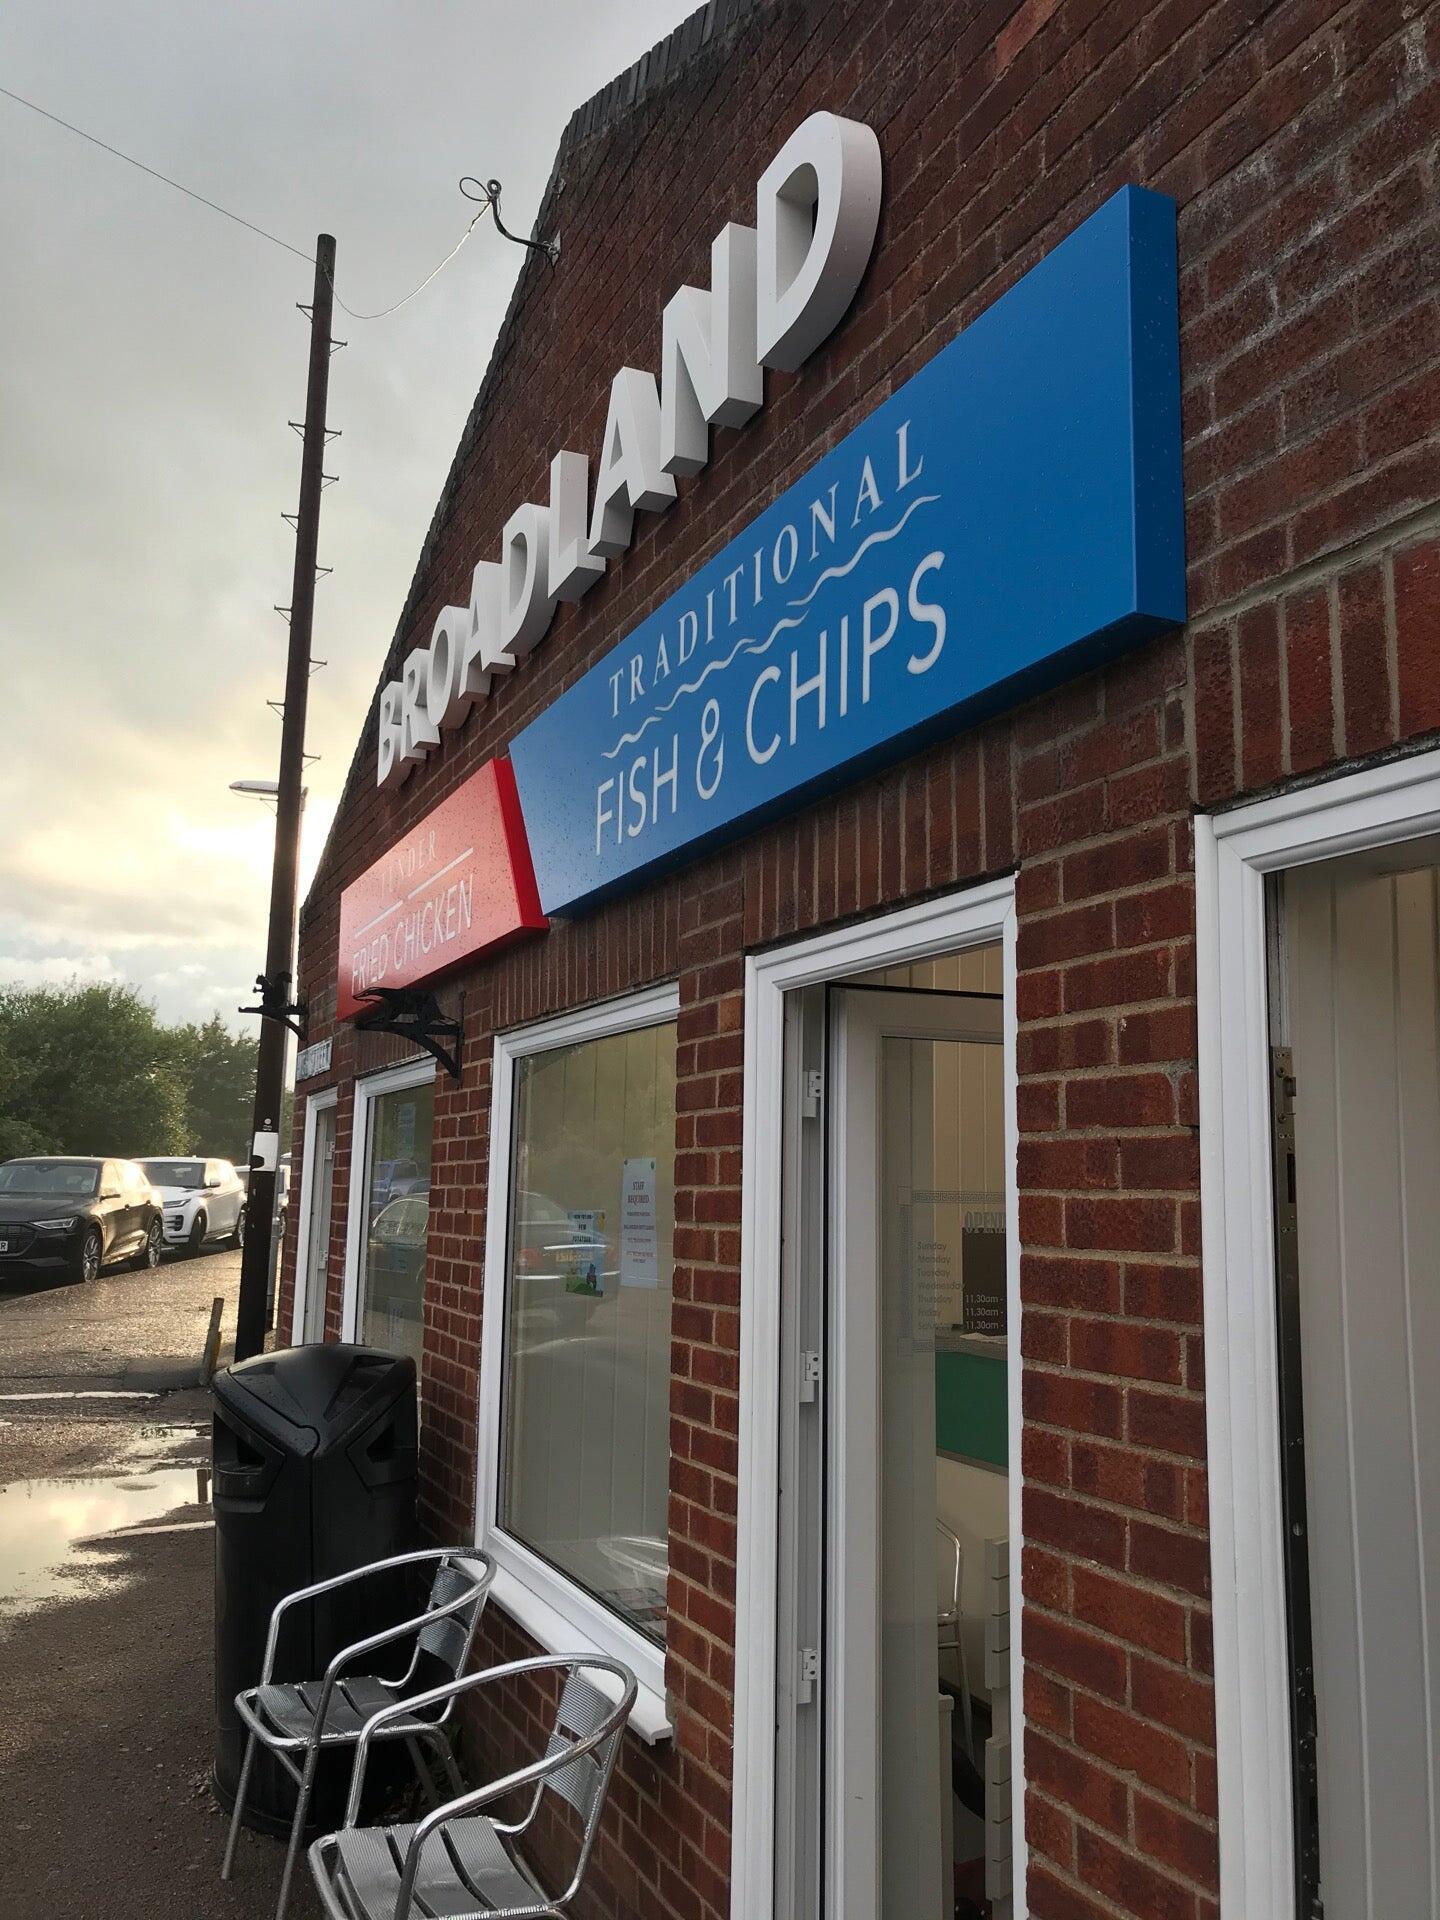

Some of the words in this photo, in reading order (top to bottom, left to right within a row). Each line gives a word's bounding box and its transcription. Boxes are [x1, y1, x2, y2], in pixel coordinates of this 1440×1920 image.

[377, 110, 882, 787] BROADLAND
[609, 419, 924, 719] TRADITIONAL
[595, 733, 680, 856] FISH
[695, 698, 725, 801] &
[745, 550, 947, 766] CHIPS
[351, 933, 389, 995] FRIED
[394, 873, 474, 970] CHICKEN
[917, 1241, 947, 1250] Sunday
[918, 1255, 951, 1265] Monday
[965, 1294, 999, 1304] 11.30am
[965, 1308, 999, 1317] 11.30am
[965, 1321, 999, 1330] 11.30am
